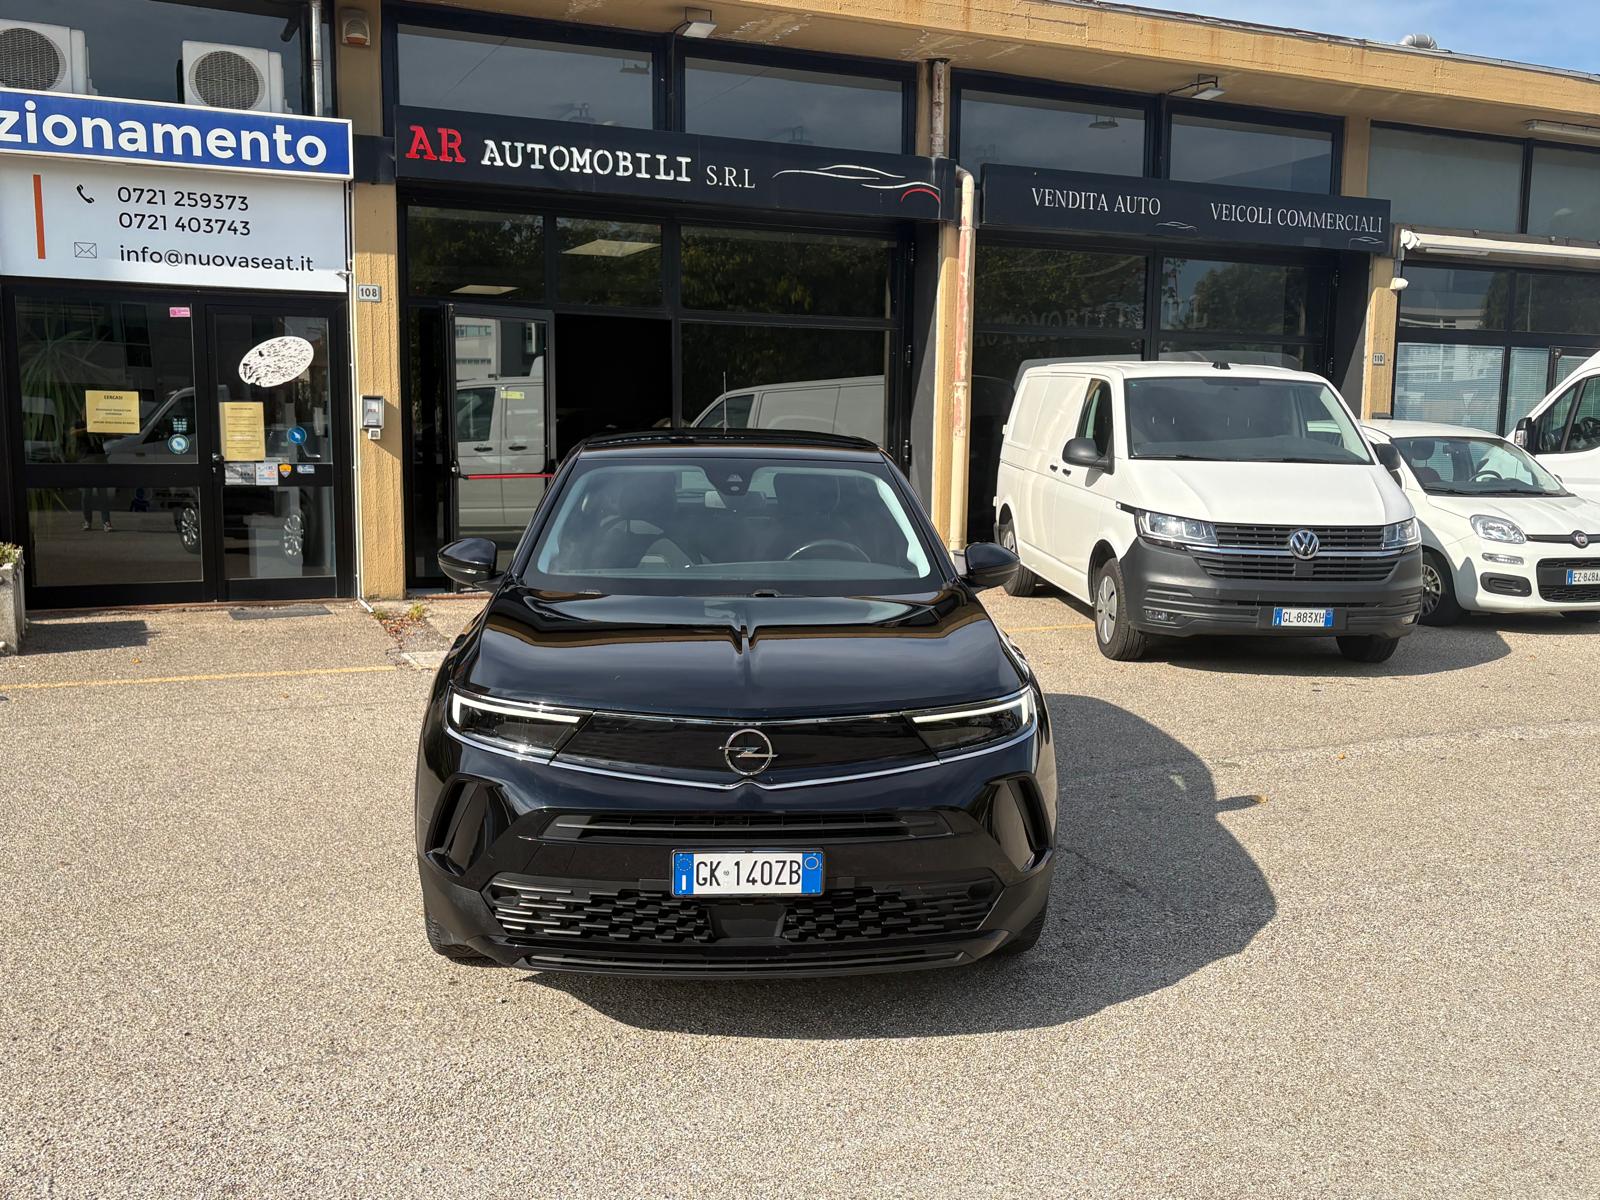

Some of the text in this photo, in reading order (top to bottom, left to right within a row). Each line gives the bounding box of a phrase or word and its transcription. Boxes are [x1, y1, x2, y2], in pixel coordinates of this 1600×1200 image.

[0, 100, 327, 166] zionamento
[405, 124, 756, 190] AR AUTOMOBILI S.R.L
[117, 186, 249, 212] 0721 259373
[1031, 187, 1161, 216] VENDITA AUTO
[118, 212, 251, 236] 0721 403743
[1210, 202, 1383, 233] VEICOLI COMMERCIALI
[120, 245, 314, 272] info@nuovaseat.it
[360, 287, 378, 298] 108
